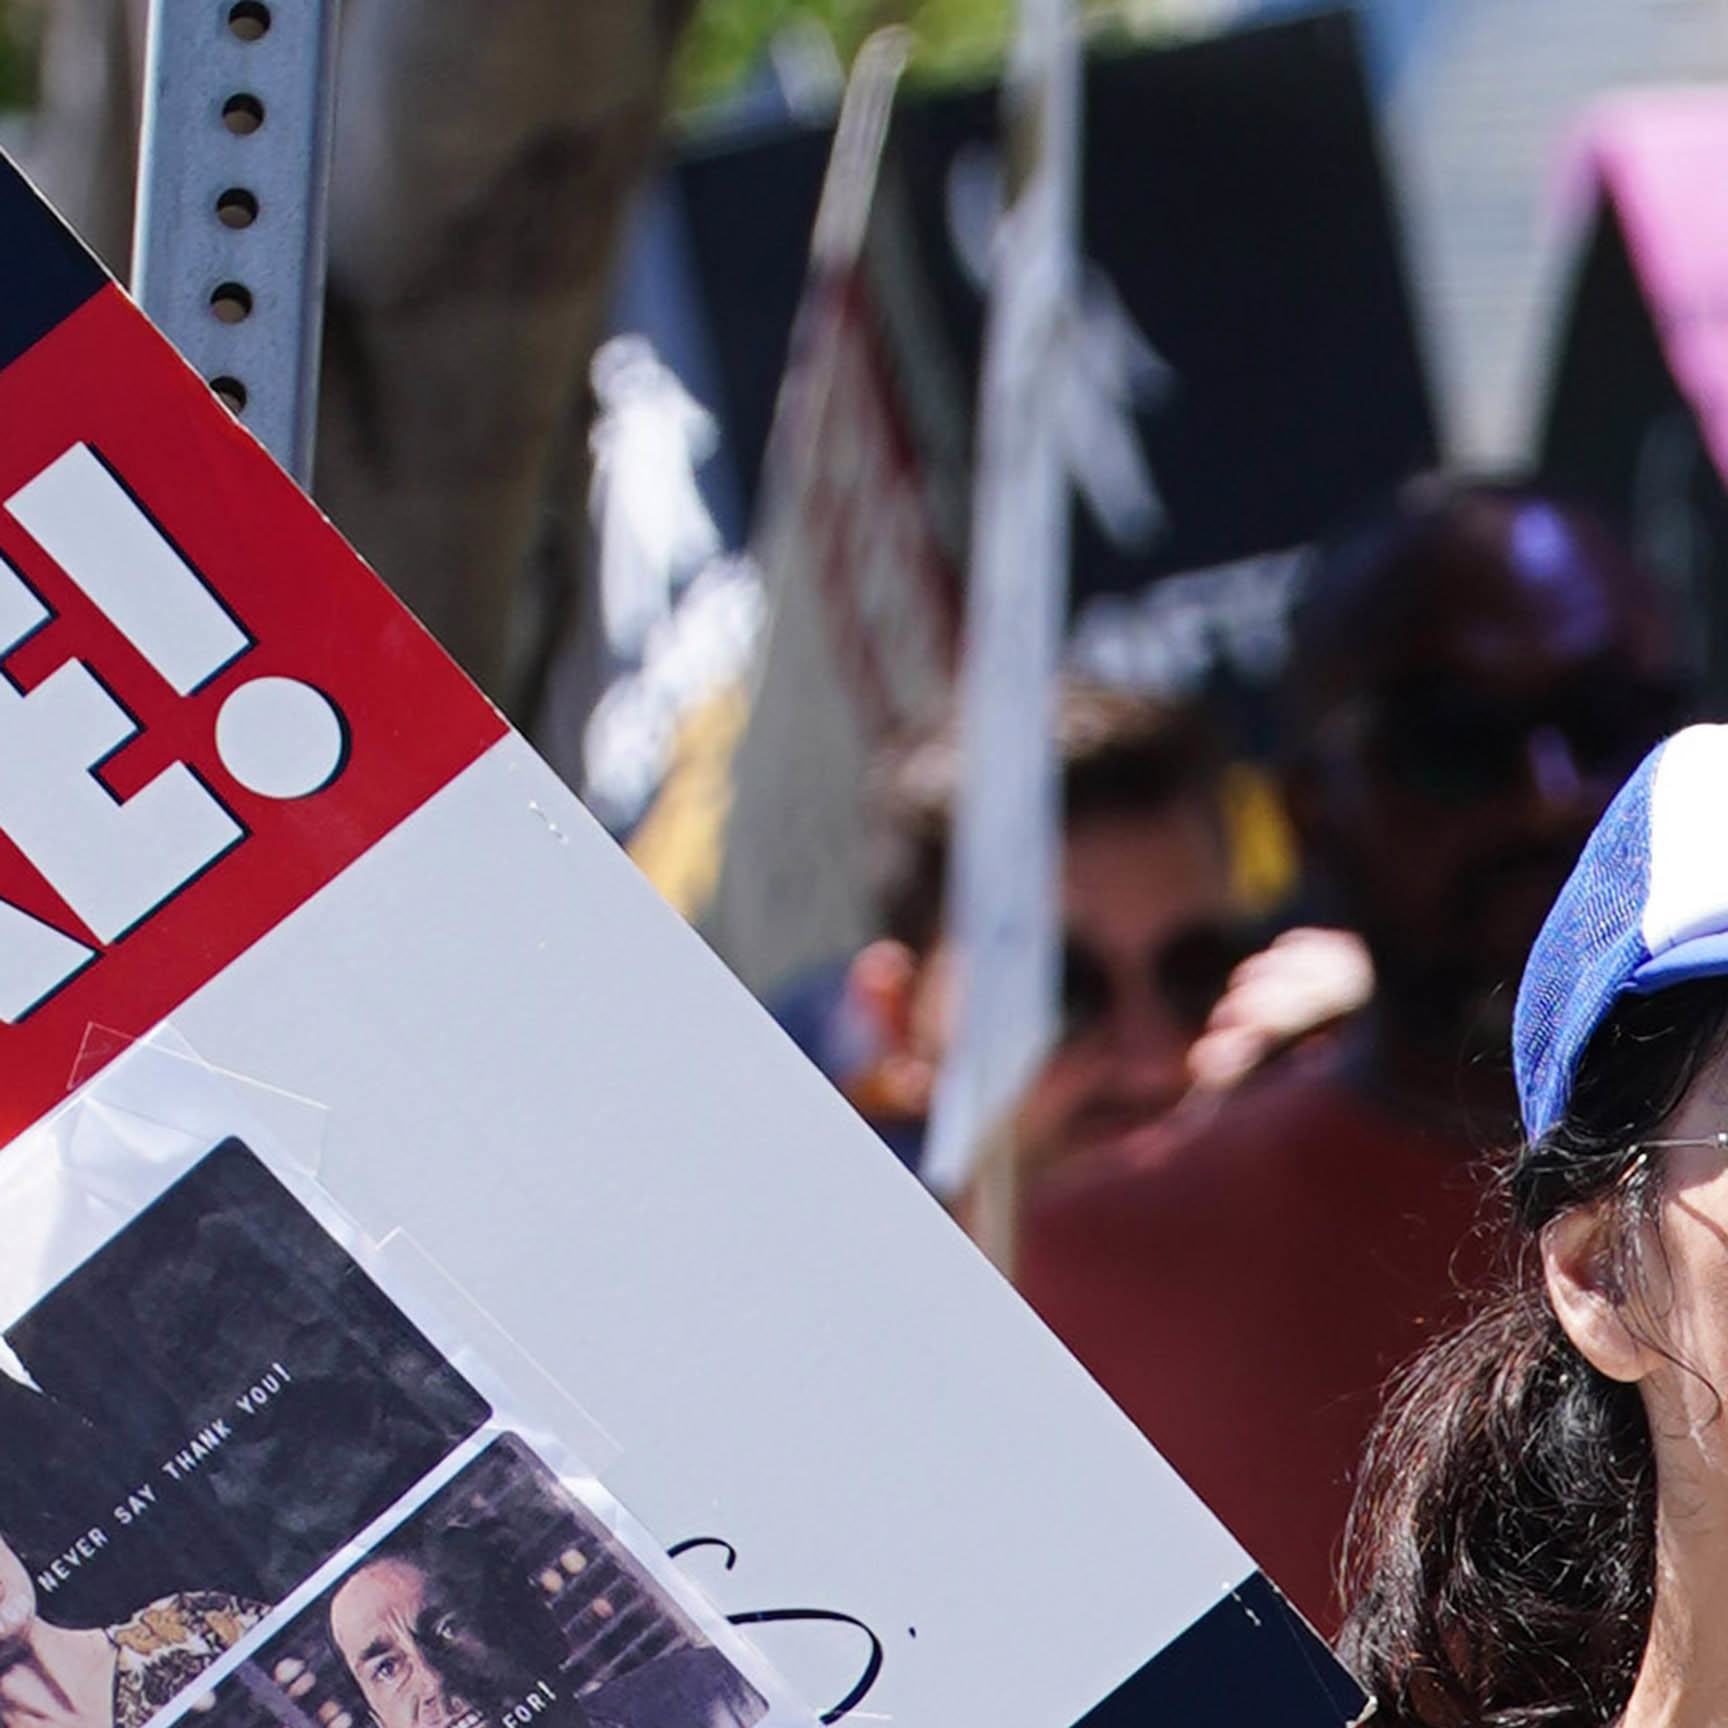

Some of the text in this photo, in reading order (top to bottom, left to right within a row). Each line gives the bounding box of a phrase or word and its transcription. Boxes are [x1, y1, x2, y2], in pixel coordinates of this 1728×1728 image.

[37, 1526, 109, 1593] NEVER
[113, 1484, 157, 1525] SAY
[162, 1418, 233, 1480] THANK
